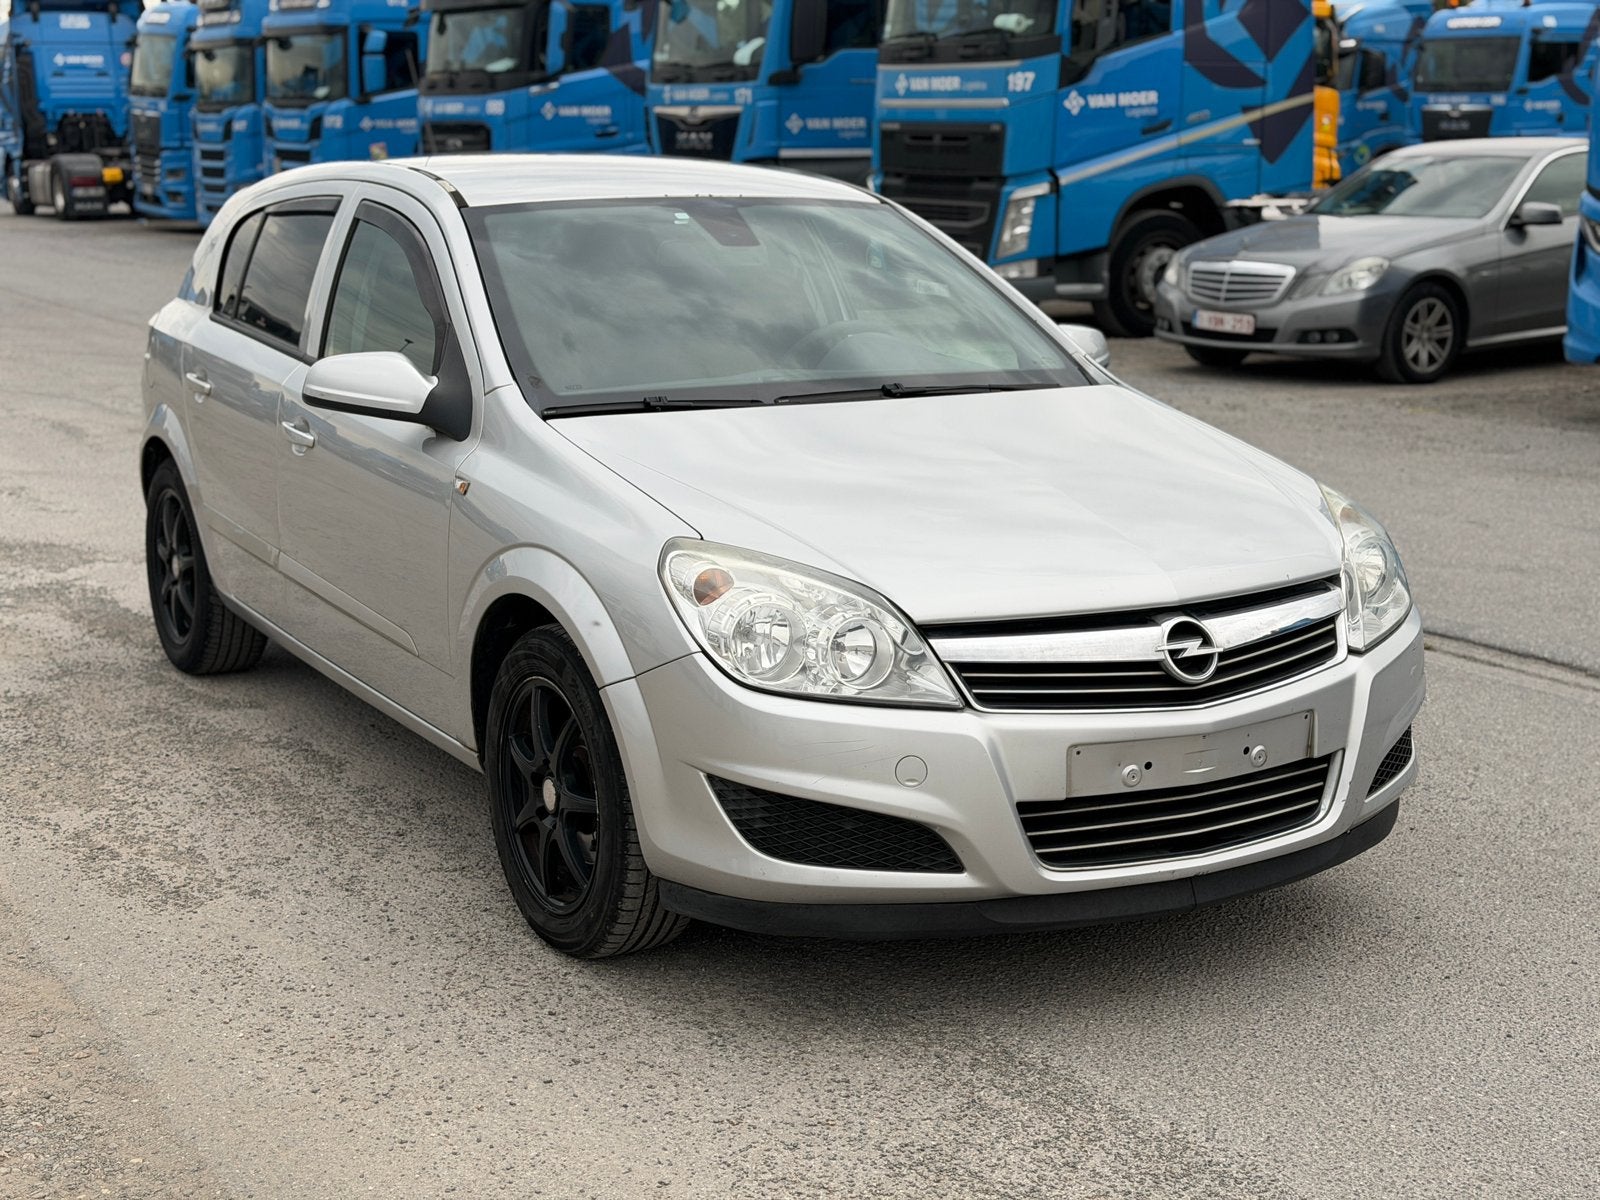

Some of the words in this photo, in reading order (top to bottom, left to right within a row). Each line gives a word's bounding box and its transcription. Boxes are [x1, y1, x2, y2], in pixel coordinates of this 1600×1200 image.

[909, 76, 929, 91] VAN
[930, 75, 961, 91] MOER
[1007, 71, 1035, 91] 197
[1087, 93, 1117, 109] VAN
[1117, 90, 1158, 107] MOER
[806, 117, 830, 130] VAN
[832, 117, 867, 129] MOER
